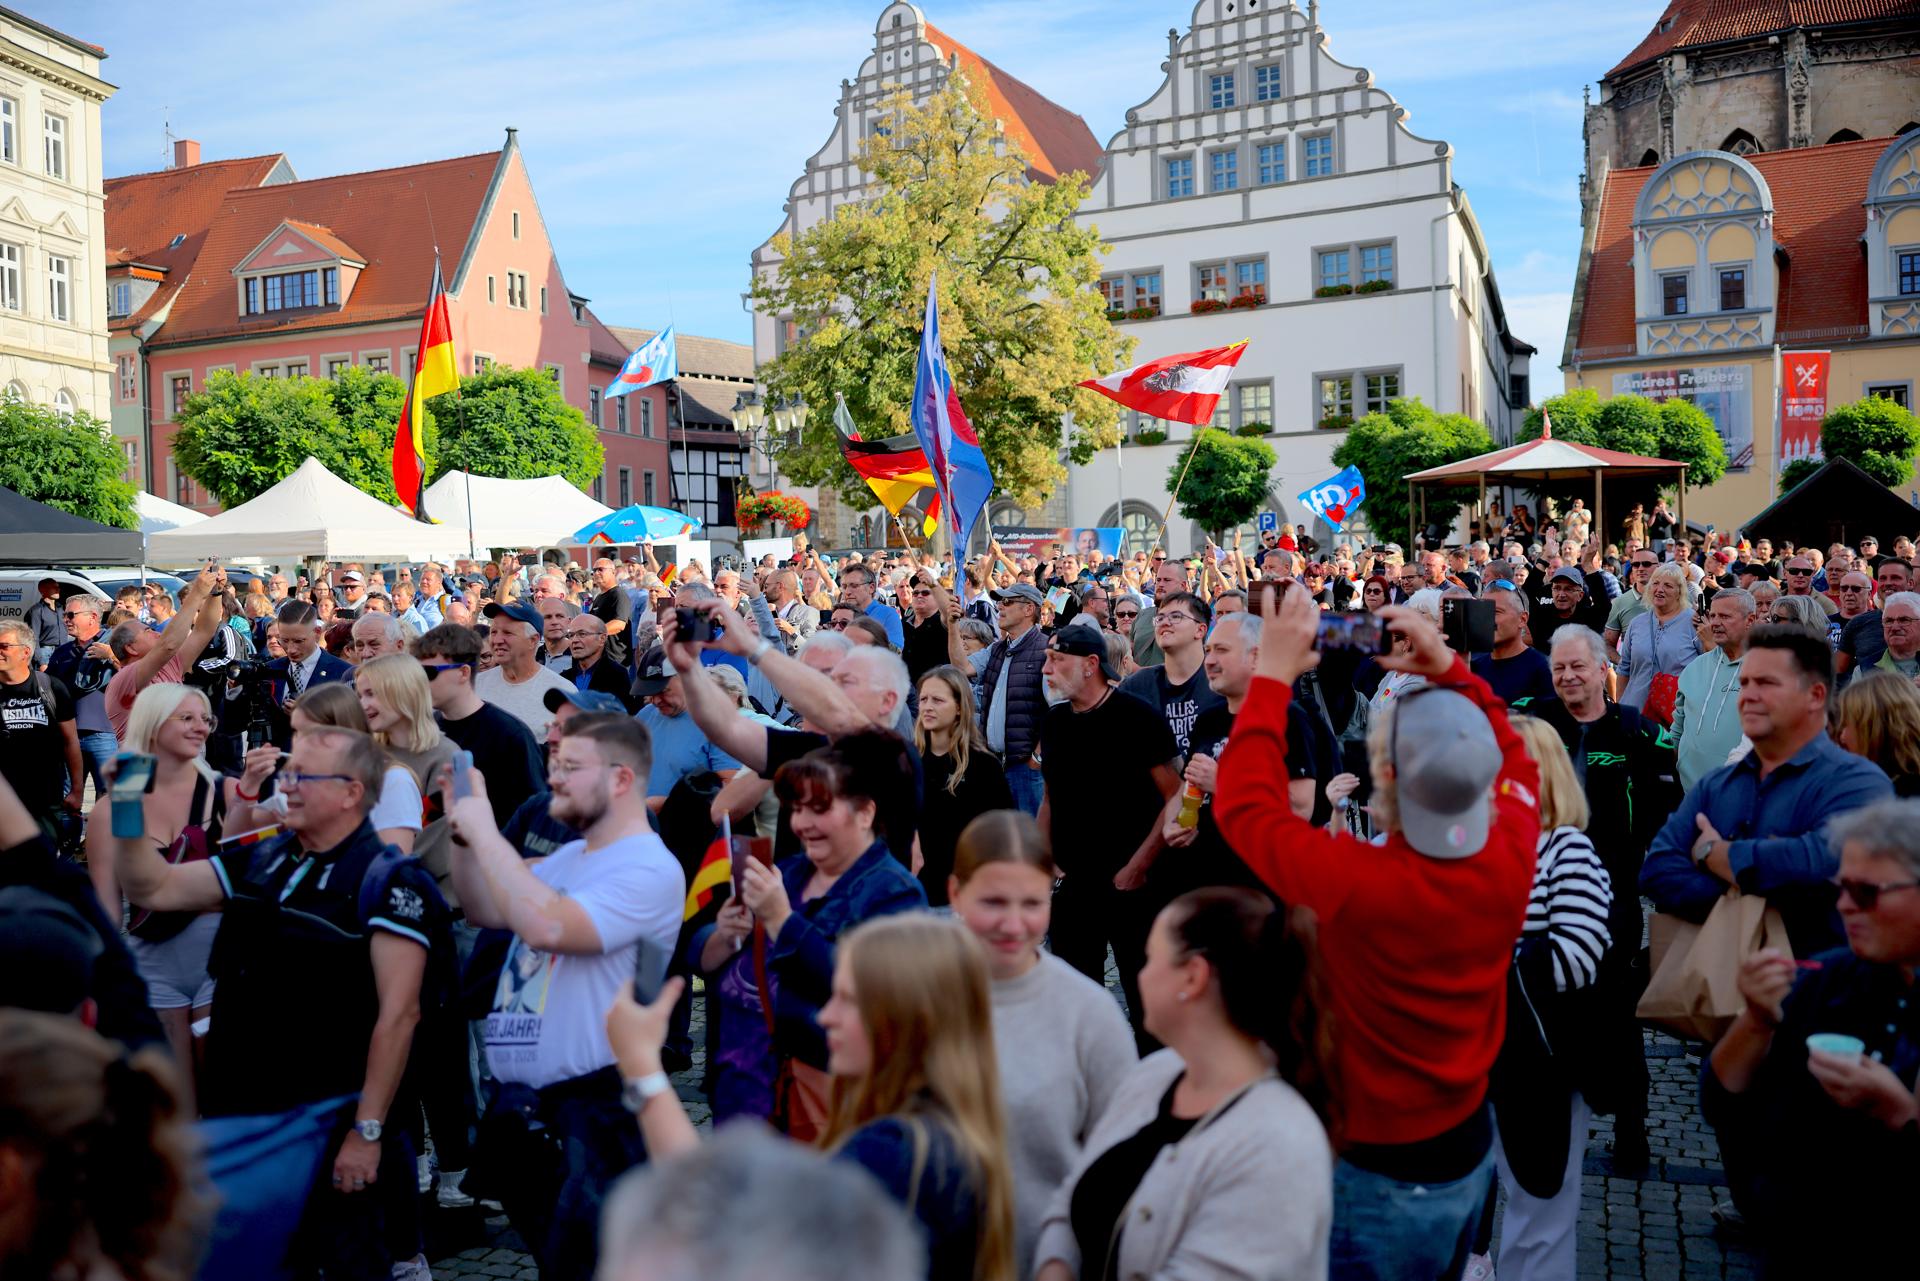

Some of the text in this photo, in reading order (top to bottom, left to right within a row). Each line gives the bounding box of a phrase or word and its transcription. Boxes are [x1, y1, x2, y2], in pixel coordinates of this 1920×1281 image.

[1623, 372, 1744, 389] Andrea Freiberg
[1263, 515, 1273, 529] P
[8, 697, 41, 707] Original
[1166, 699, 1198, 718] ALLES-
[500, 1018, 542, 1038] JAHR!
